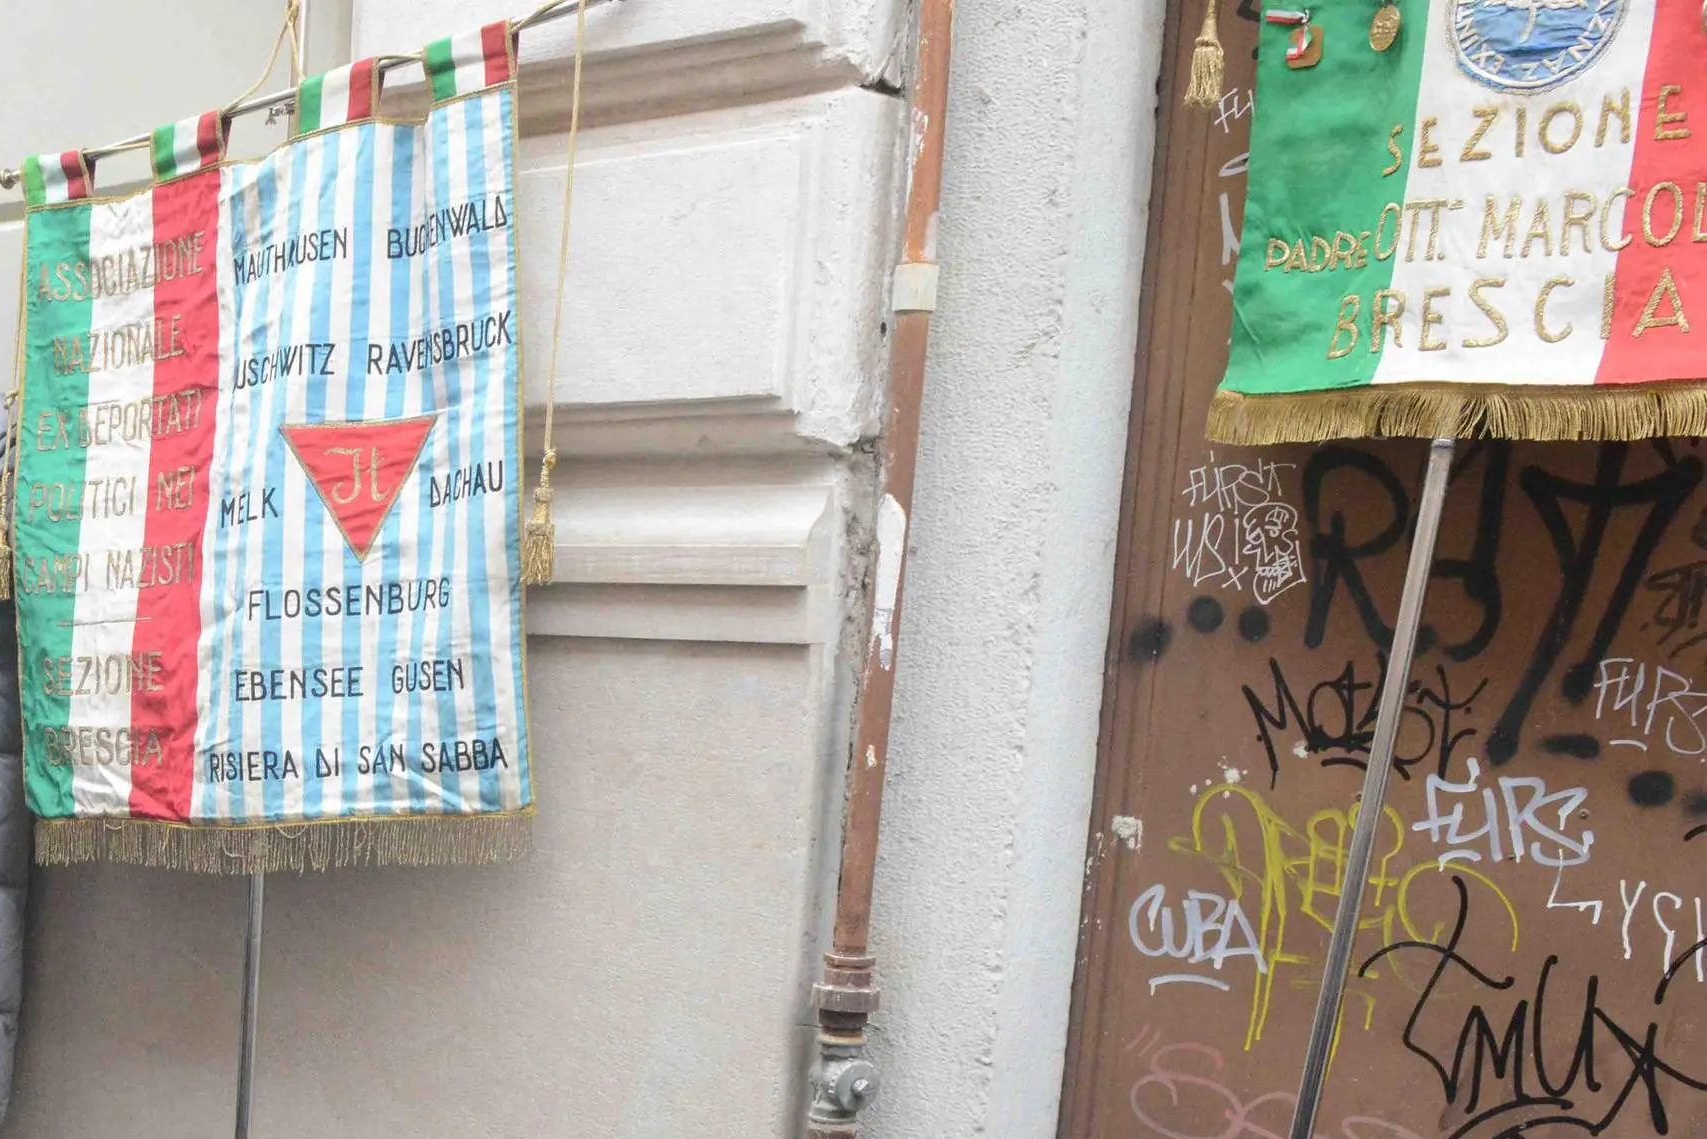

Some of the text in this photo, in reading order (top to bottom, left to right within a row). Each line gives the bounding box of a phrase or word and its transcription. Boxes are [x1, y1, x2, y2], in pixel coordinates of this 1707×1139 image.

[1382, 84, 1693, 177] SEZIONE
[37, 231, 205, 304] ASSOCIAZIONE
[1264, 230, 1371, 273] PADRE
[367, 310, 513, 375] RAVENSBRUCK
[1327, 267, 1691, 360] BRESCIA
[52, 314, 185, 377] NAZIONALE
[37, 388, 205, 451] EX DEPORTATI
[28, 465, 198, 523] POLITICI NEI
[221, 460, 504, 528] MELK DACHAU
[20, 542, 196, 595] CAMPI NAZISTI
[248, 577, 452, 621] FLOSSENBURG
[41, 652, 166, 697] SEZIONE
[235, 658, 465, 702] EBENSEE GUSEN
[44, 725, 165, 768] BRESCIA
[208, 737, 509, 784] RISIERA DI SAN SABBA
